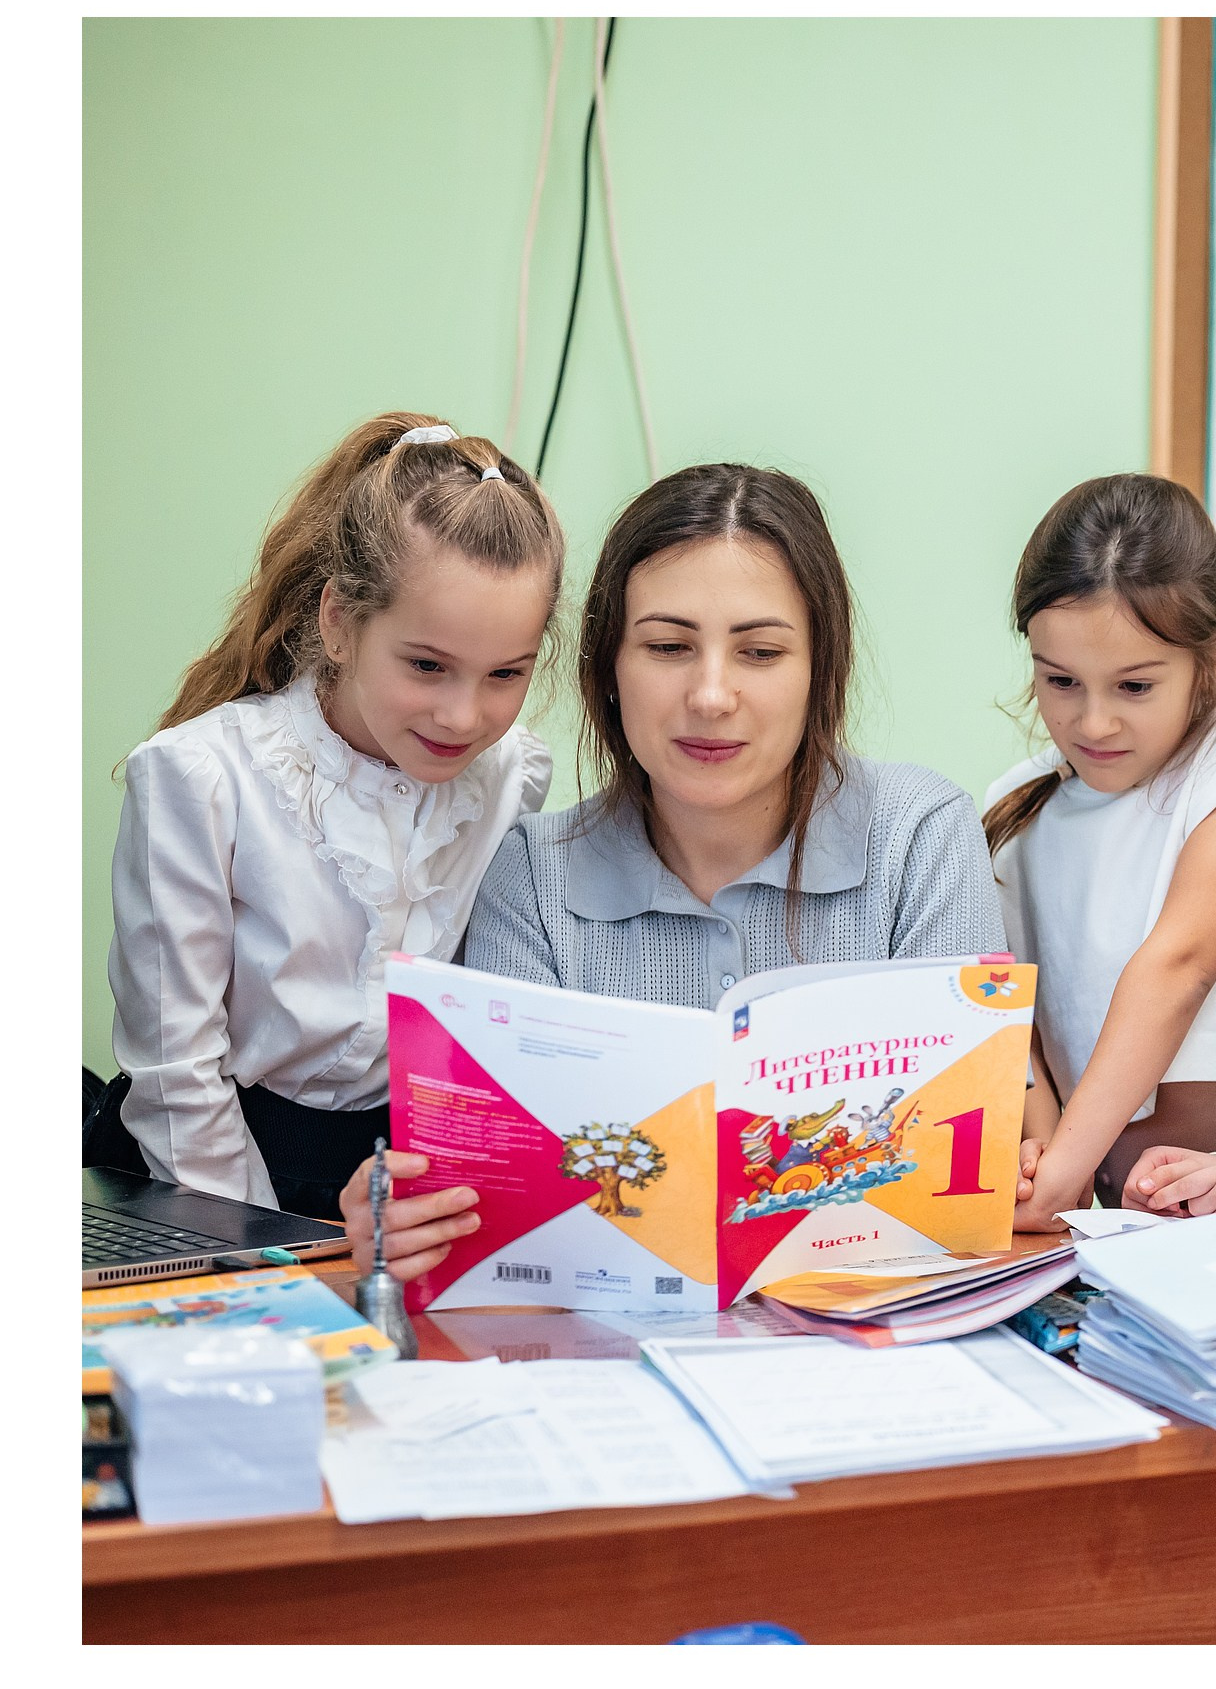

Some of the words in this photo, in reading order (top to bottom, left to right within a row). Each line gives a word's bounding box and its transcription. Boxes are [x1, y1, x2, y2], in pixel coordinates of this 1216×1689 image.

[744, 1033, 954, 1086] Литературное
[775, 1055, 919, 1095] ЧТЕНИЕ
[931, 1107, 996, 1198] 1
[871, 1230, 879, 1240] 1
